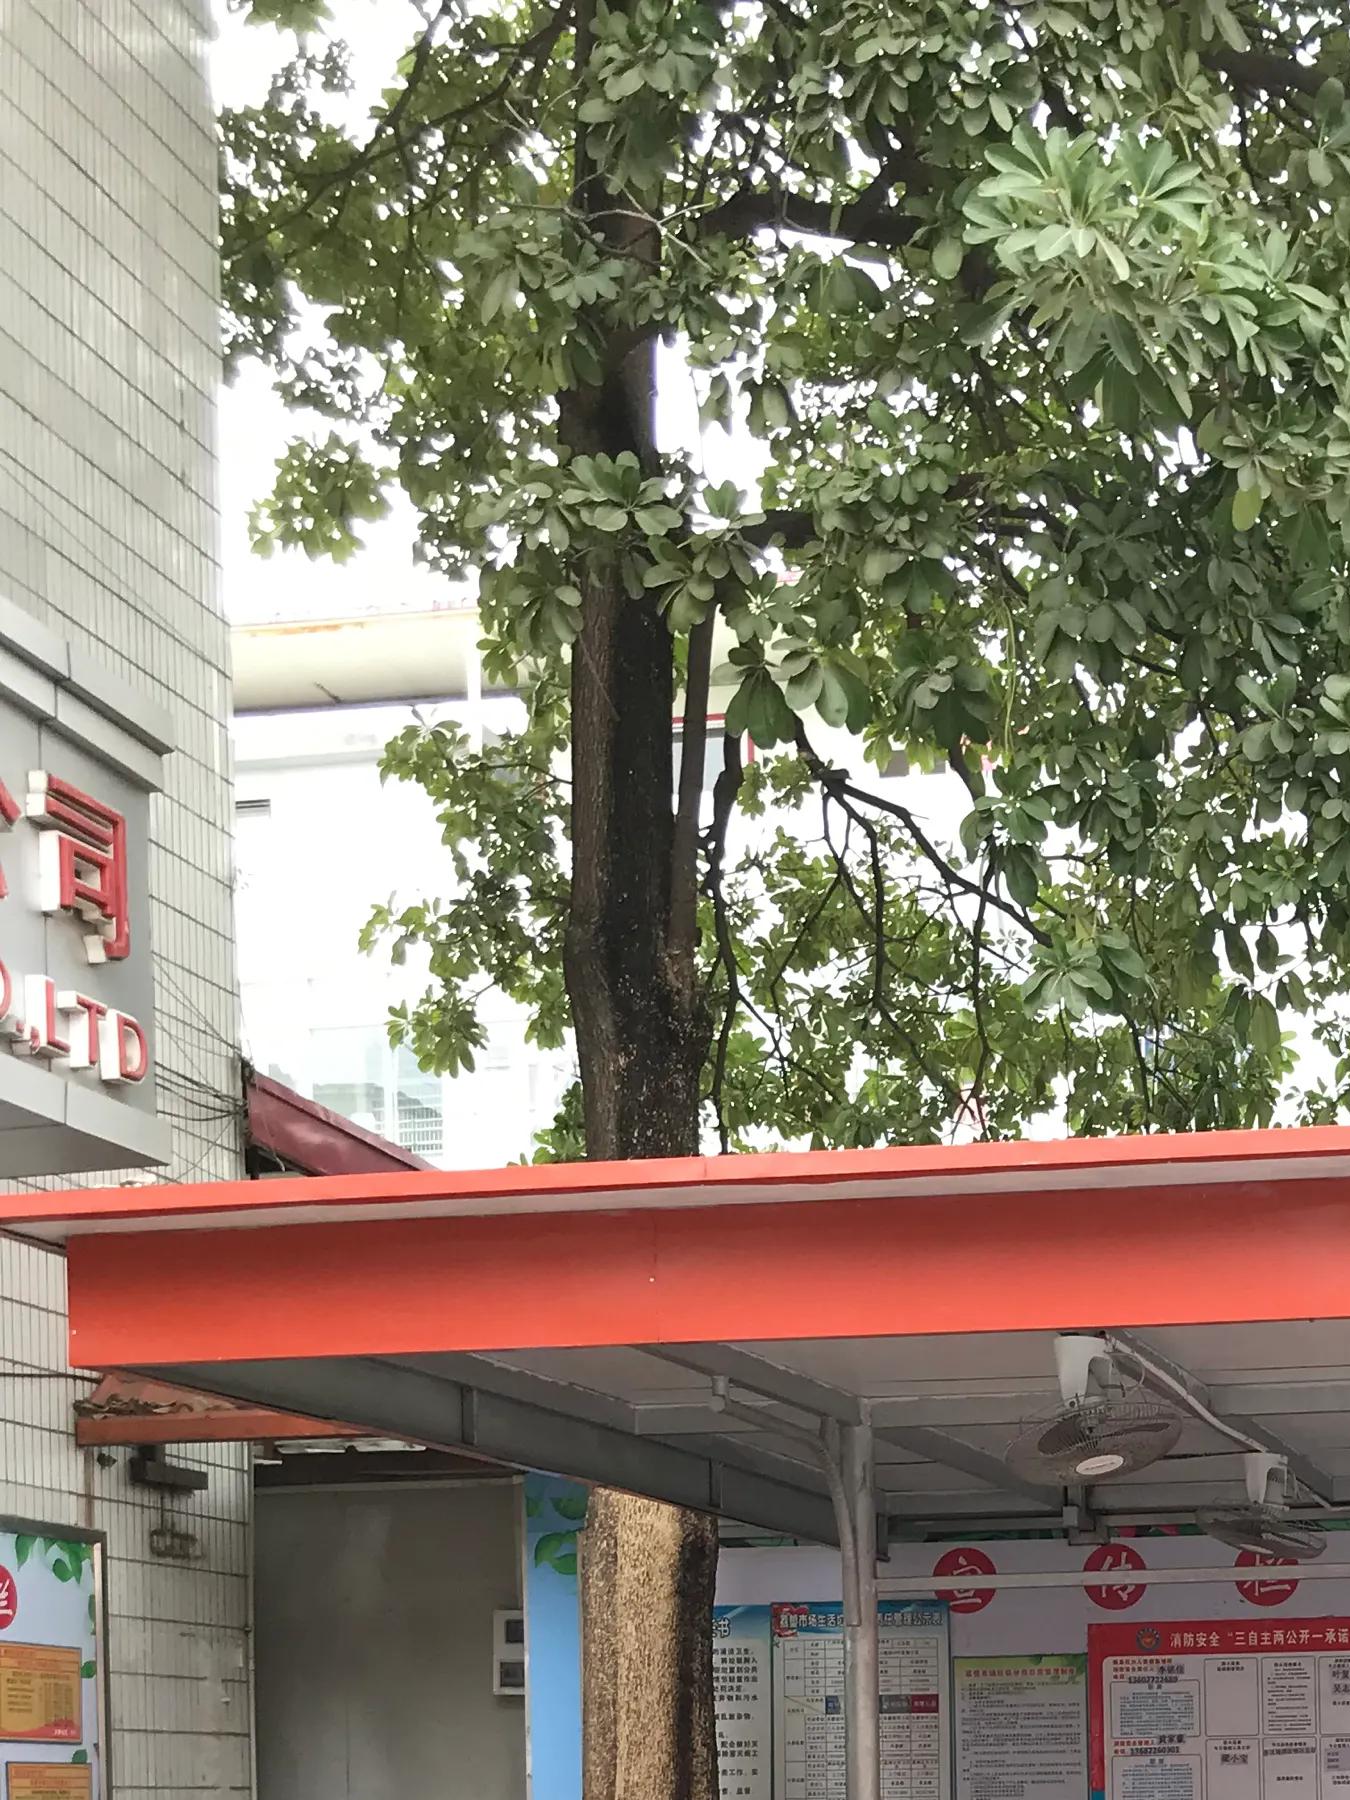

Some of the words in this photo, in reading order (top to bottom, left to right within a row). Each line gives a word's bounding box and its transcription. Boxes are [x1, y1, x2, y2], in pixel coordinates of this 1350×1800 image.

[0, 770, 130, 962] 司
[1170, 1632, 1220, 1648] 消防安全
